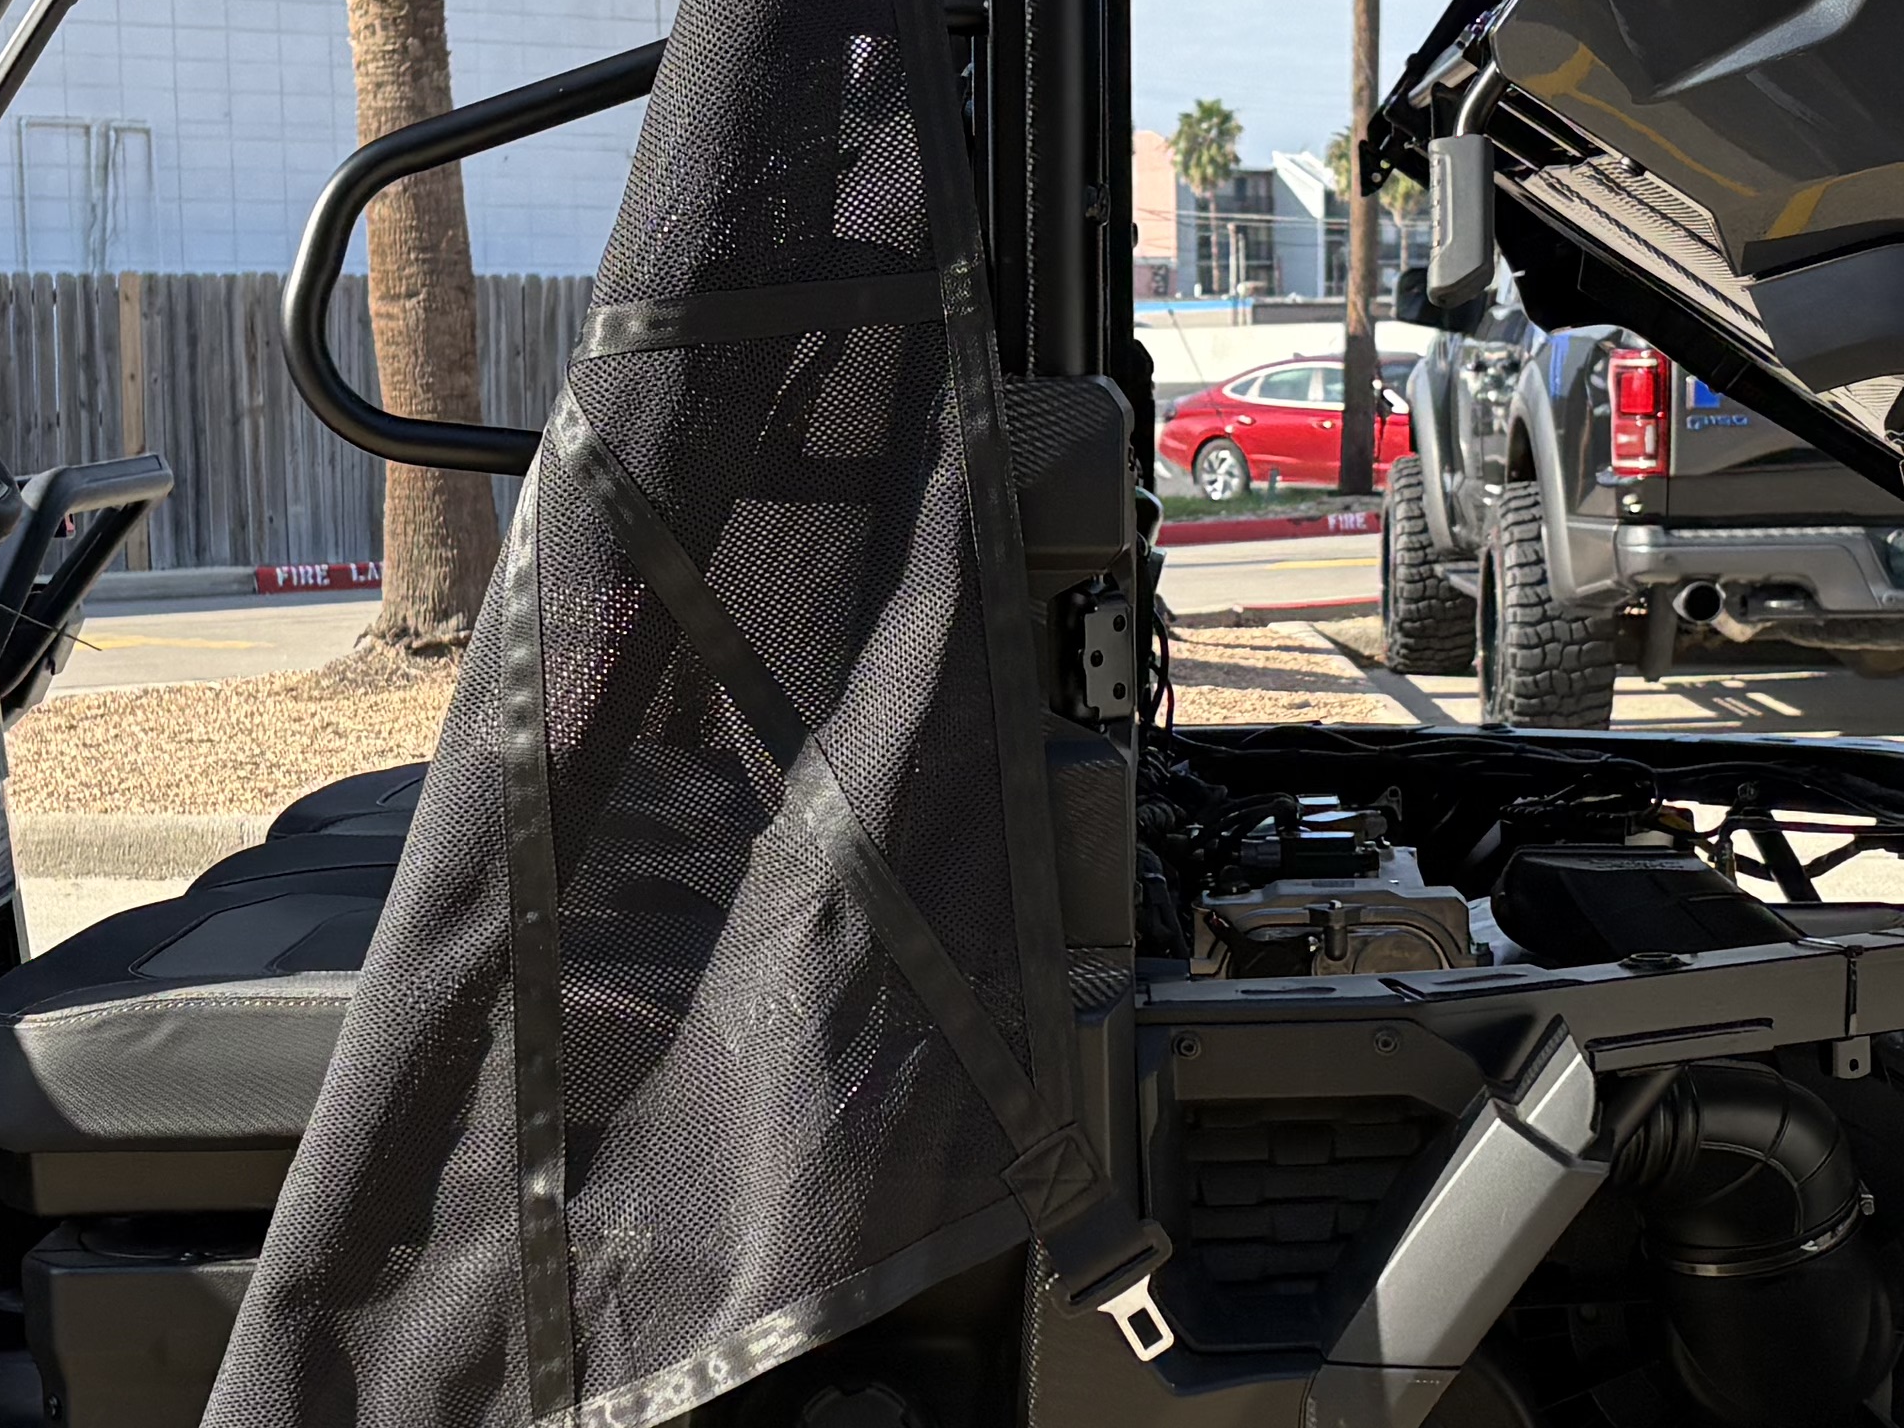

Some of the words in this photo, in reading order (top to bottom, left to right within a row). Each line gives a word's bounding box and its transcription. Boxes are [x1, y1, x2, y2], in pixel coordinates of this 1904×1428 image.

[1327, 512, 1368, 532] FIRE
[275, 564, 331, 588] FIRE
[349, 561, 385, 583] LA
